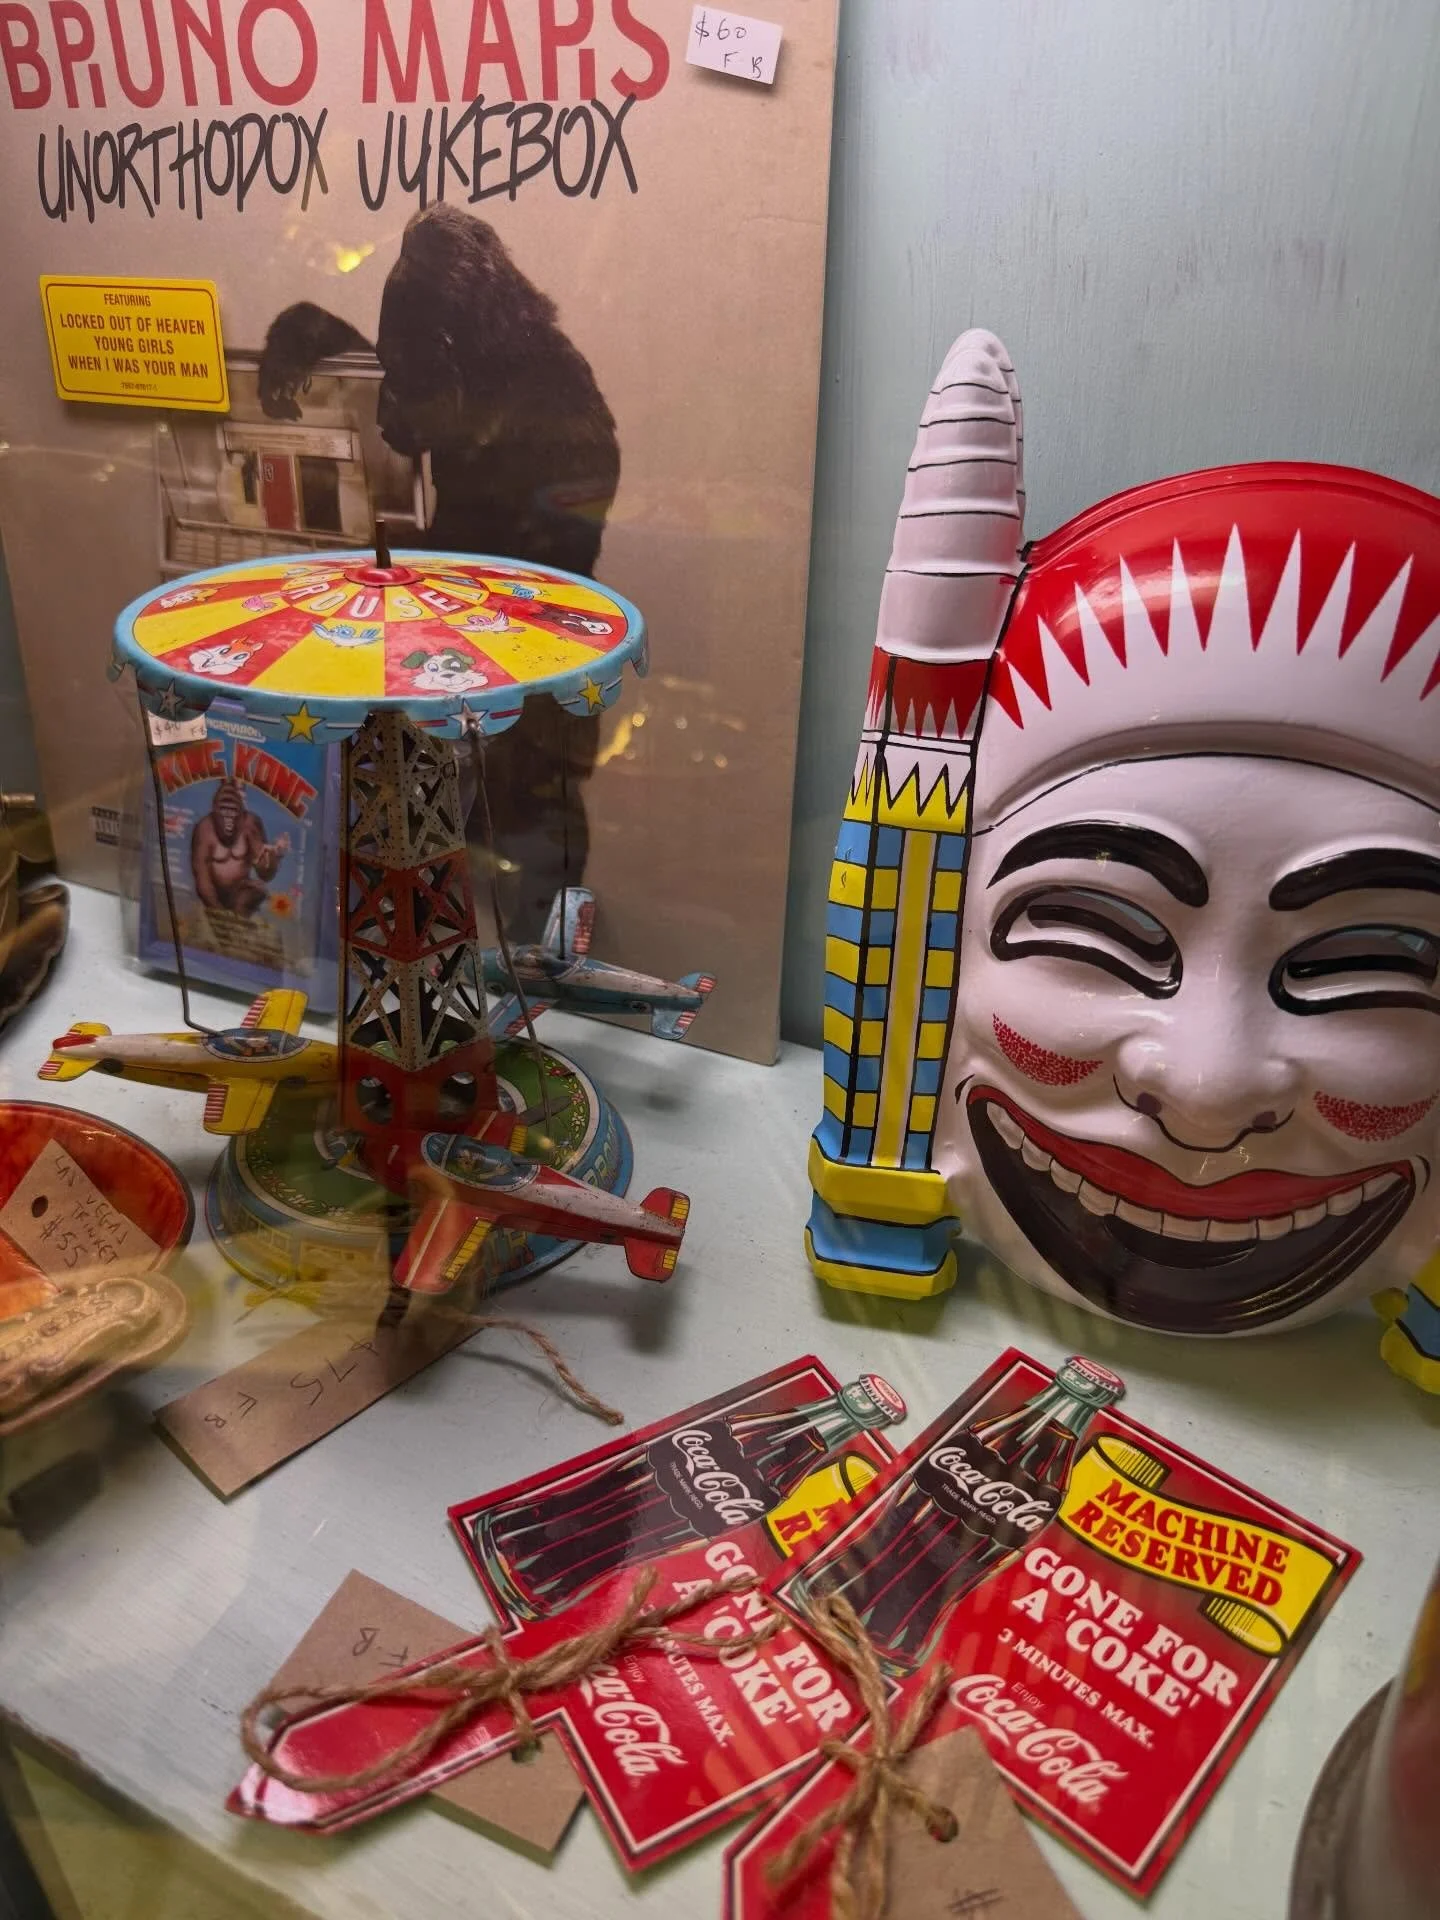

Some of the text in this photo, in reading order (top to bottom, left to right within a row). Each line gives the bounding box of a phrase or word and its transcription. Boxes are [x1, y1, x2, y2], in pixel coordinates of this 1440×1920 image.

[0, 0, 670, 109] BRUNO MARS
[38, 94, 638, 224] UNORTHODOX JUKEBOX
[60, 314, 205, 335] LOCKED OUT OF HEAVEN
[104, 293, 151, 306] FEATURING
[68, 355, 209, 378] WHEN I WAS YOUR MAN
[94, 336, 175, 355] YOUNG GIRLS
[232, 740, 319, 821] KONG
[929, 1447, 1054, 1532] Coca-Cola
[941, 1483, 960, 1500] TRADE
[1096, 1479, 1290, 1574] MACHINE
[1068, 1500, 1282, 1606] RESERVED
[1012, 1588, 1049, 1623] A
[1025, 1548, 1239, 1706] GONE FOR
[624, 1654, 646, 1683] Enjoy
[656, 1627, 705, 1695] NUTES
[696, 1695, 736, 1748] MAX.
[773, 1641, 852, 1732] FOR
[998, 1628, 1154, 1749] 3 MINUTES MAX.
[1011, 1682, 1045, 1709] Enjoy
[579, 1662, 688, 1777] ca-Cola
[950, 1674, 1129, 1802] Coca-Cola
